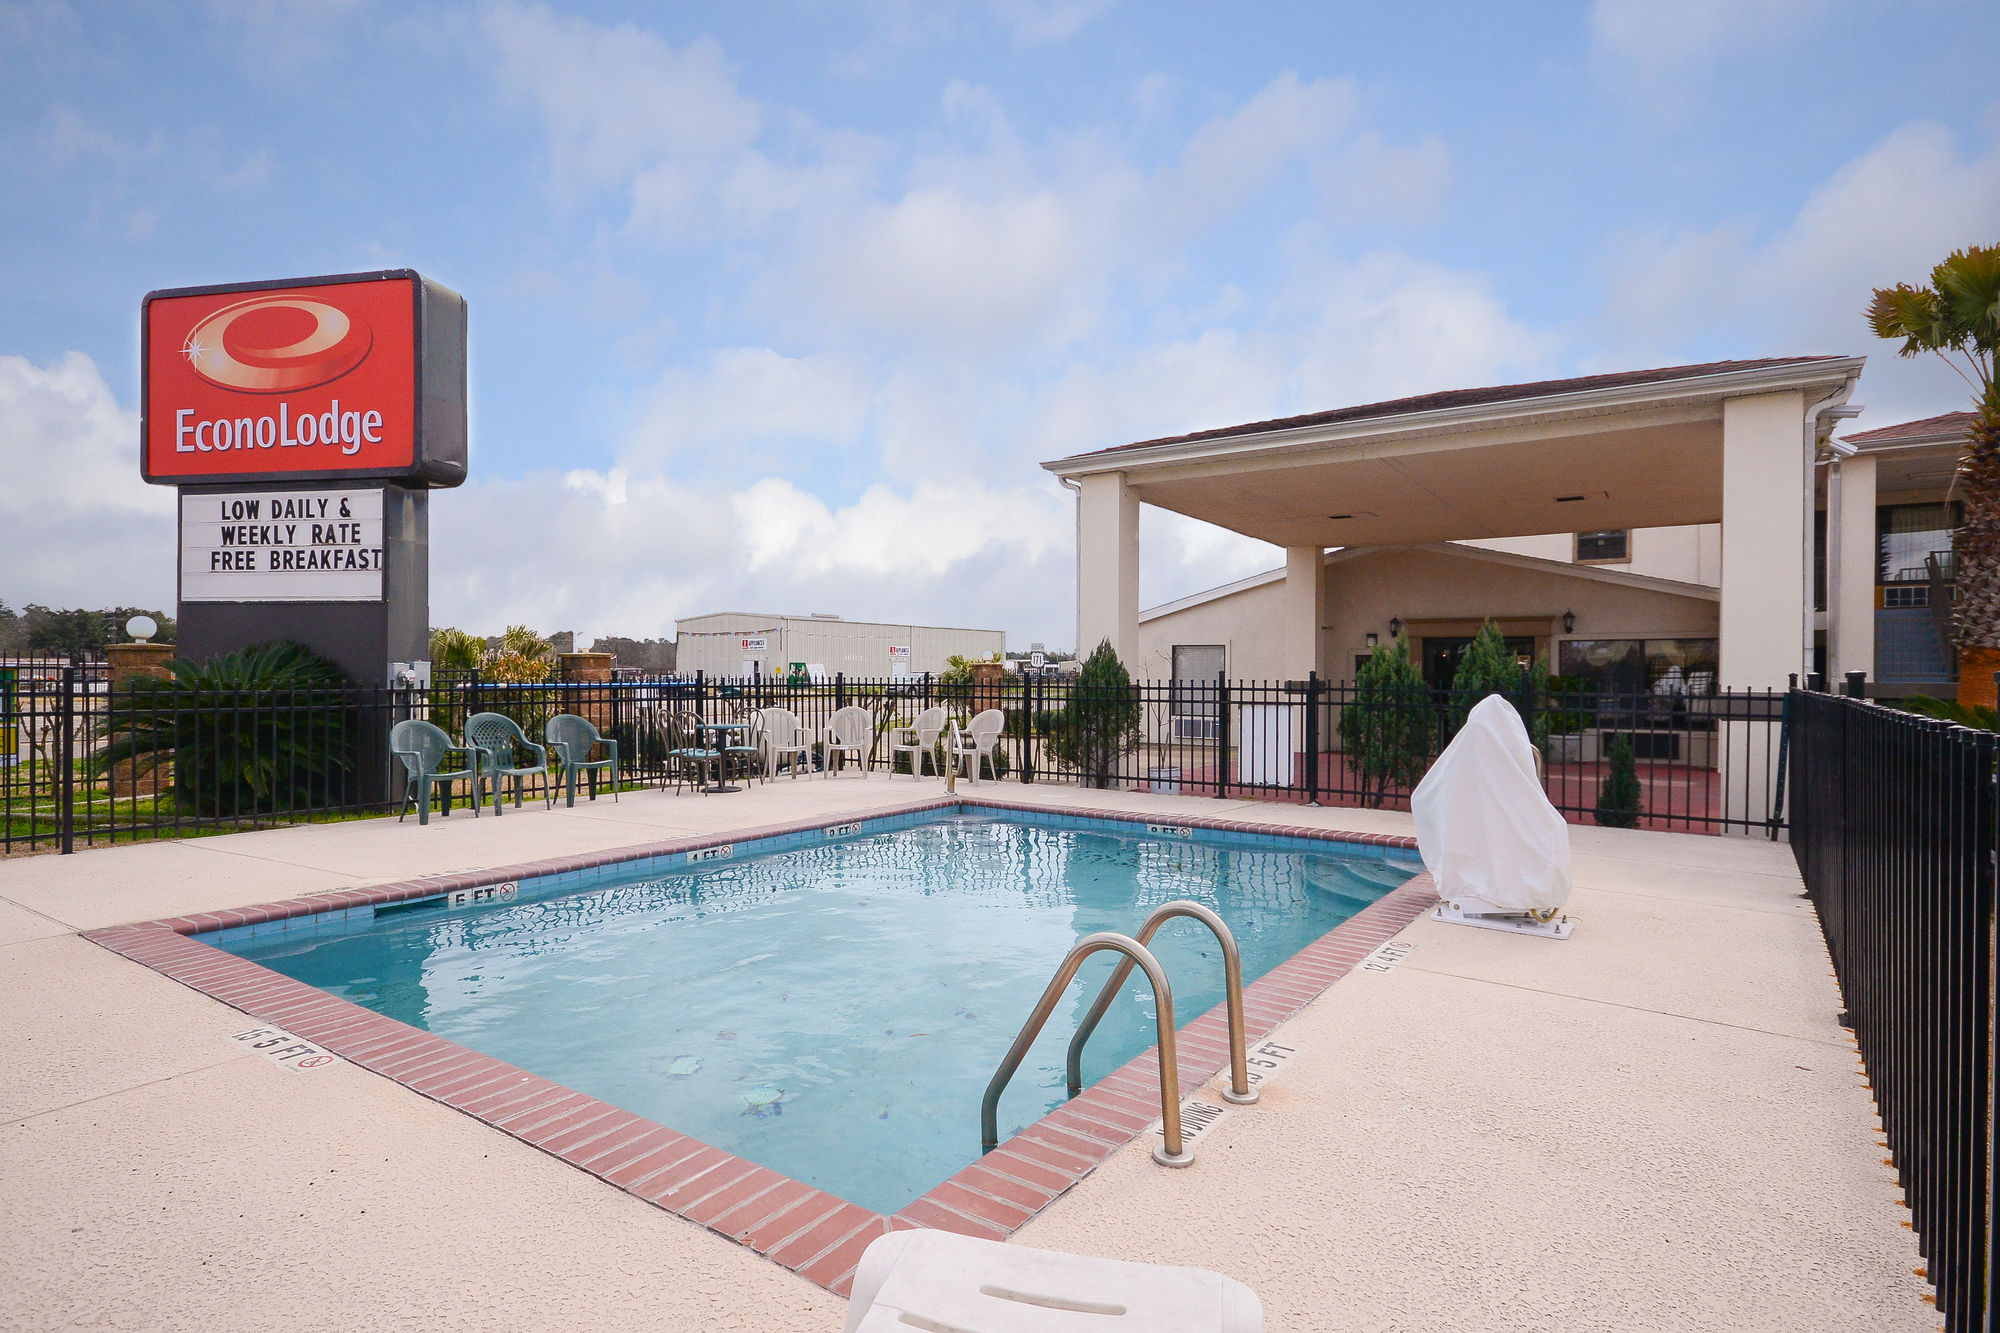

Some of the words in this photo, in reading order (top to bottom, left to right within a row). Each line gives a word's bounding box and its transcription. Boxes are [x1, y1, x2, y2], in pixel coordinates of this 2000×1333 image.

[176, 400, 383, 455] EconoLodge
[221, 500, 260, 521] LOW
[271, 498, 328, 520] DAILY
[339, 497, 351, 518] &
[221, 524, 297, 546] WEEKLY
[311, 523, 361, 545] RATE
[210, 550, 256, 571] FREE
[269, 549, 383, 571] BREAKFAST
[1033, 655, 1042, 665] 171
[252, 1036, 290, 1049] 5
[269, 1044, 317, 1060] FT
[1257, 1041, 1296, 1059] FT
[1180, 1102, 1223, 1131] DIVING
